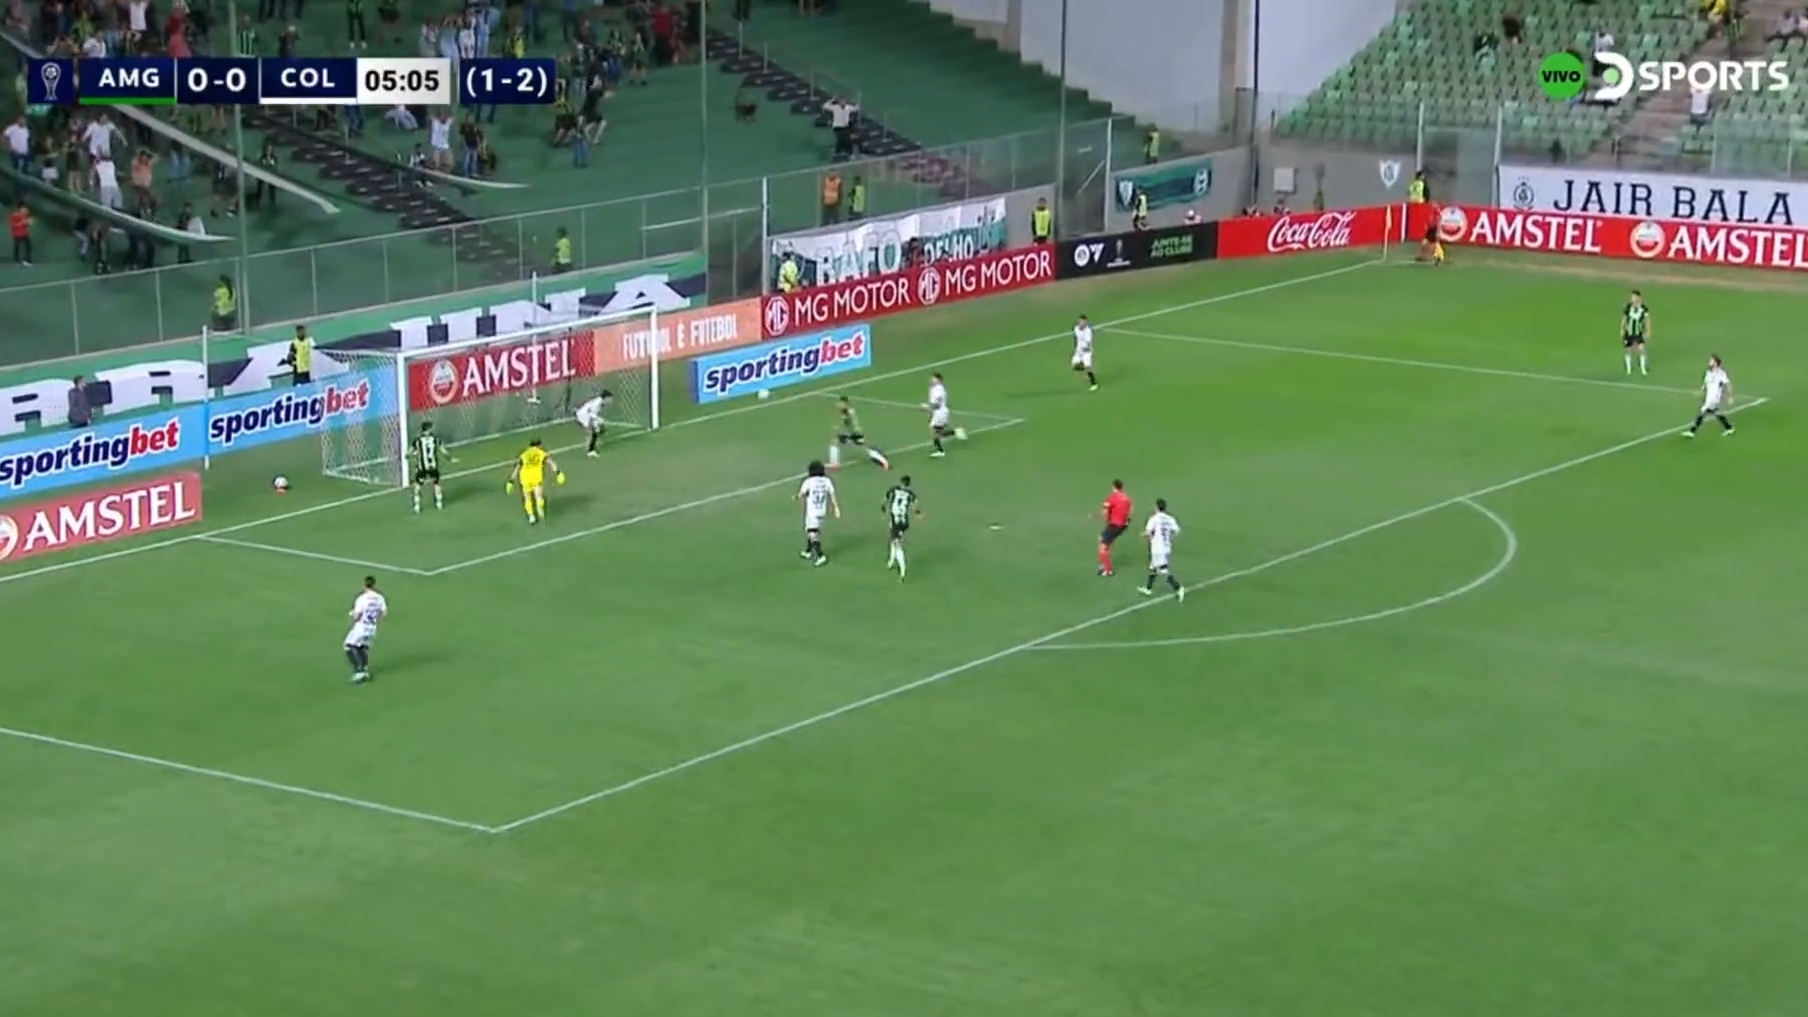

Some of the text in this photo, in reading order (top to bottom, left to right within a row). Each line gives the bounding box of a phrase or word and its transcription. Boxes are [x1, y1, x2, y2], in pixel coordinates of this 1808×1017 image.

[1553, 179, 1793, 225] JAIR BALA
[1267, 211, 1356, 252] Coca-Cola
[1469, 211, 1602, 252] AMSTEL
[1667, 224, 1808, 269] AMSTEL
[817, 231, 902, 286] BAFO
[945, 266, 975, 295] MG
[980, 250, 1051, 287] MOTOR
[794, 293, 828, 327] MG
[834, 277, 910, 319] MOTOR
[690, 313, 738, 347] FUTEBOL
[462, 340, 575, 397] AMSTEL
[704, 333, 865, 393] sportingbet
[210, 382, 369, 443] sportingbet
[0, 421, 179, 485] sportingbet
[24, 482, 195, 552] AMSTEL
